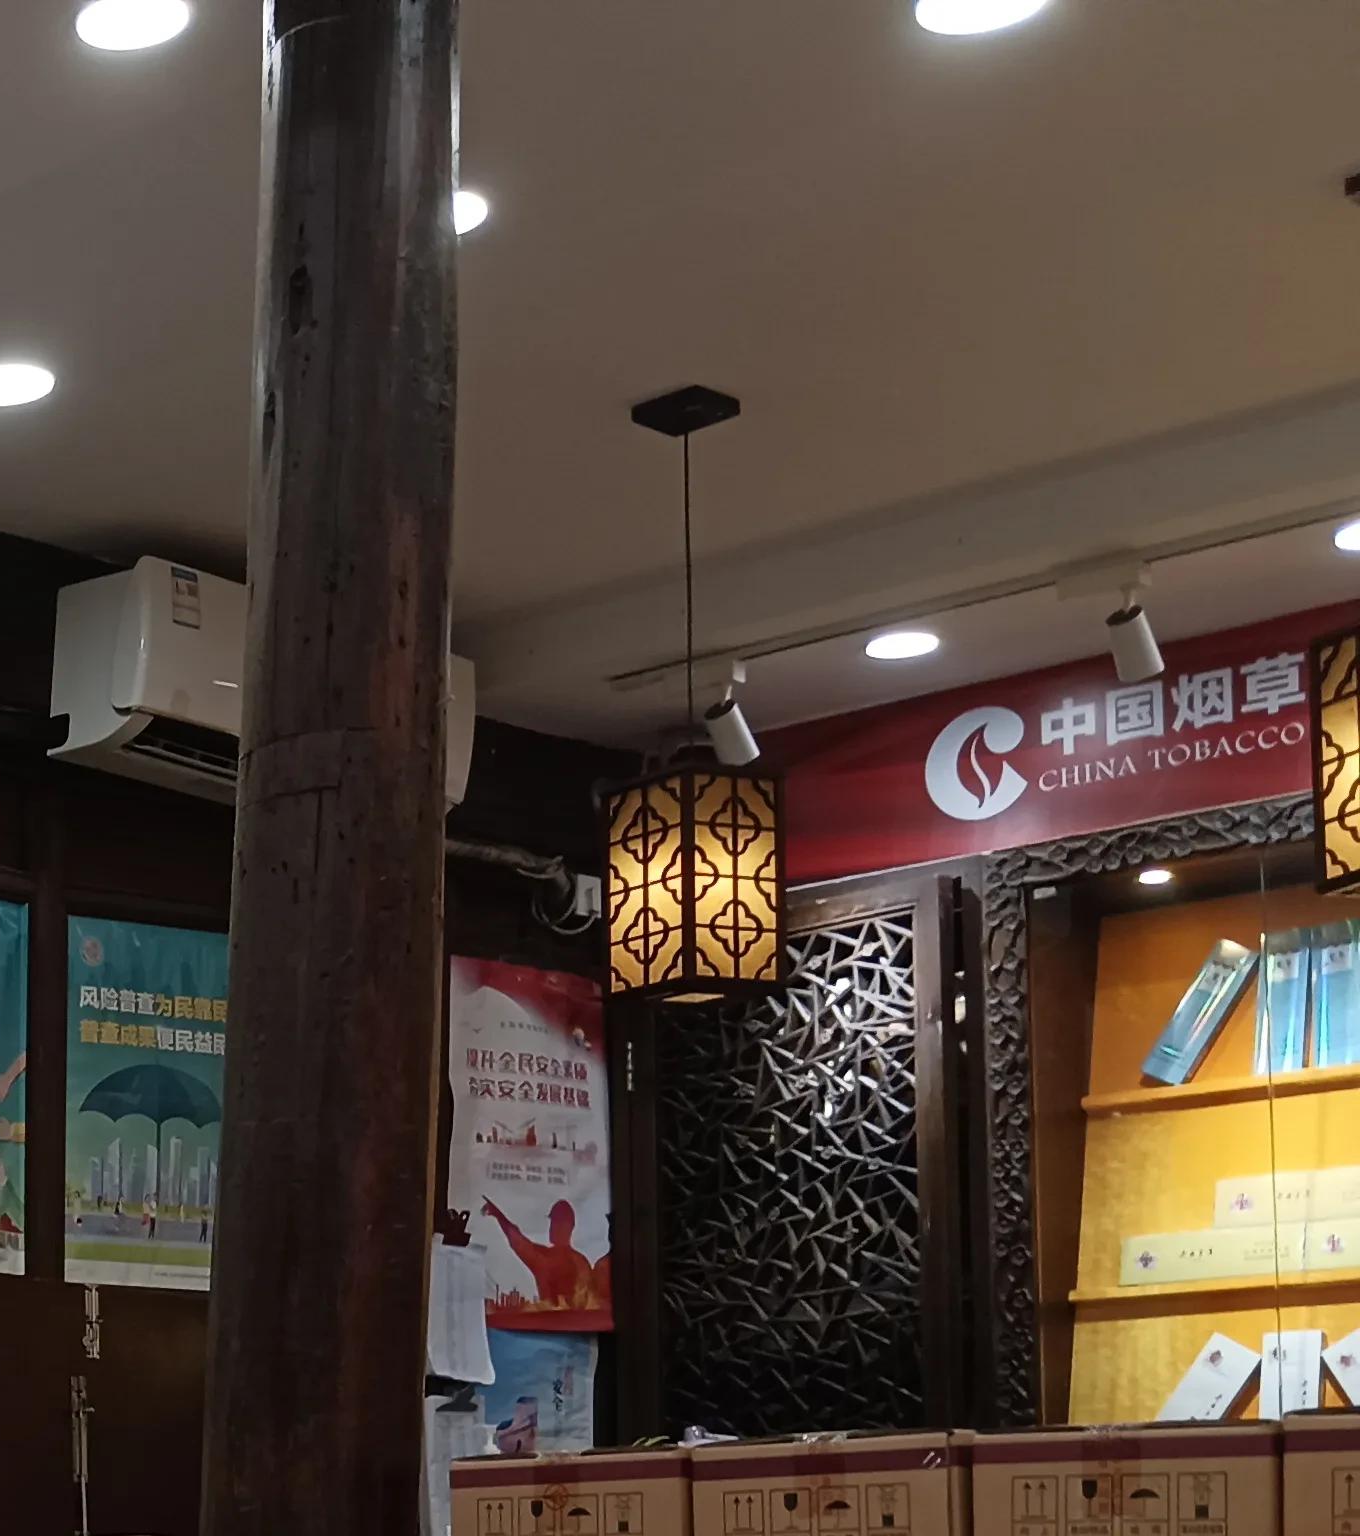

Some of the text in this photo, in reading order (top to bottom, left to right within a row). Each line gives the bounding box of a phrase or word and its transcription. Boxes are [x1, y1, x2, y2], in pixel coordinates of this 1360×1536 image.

[1041, 653, 1306, 756] 中国烟草
[1038, 722, 1304, 793] CHINA TOBACCO
